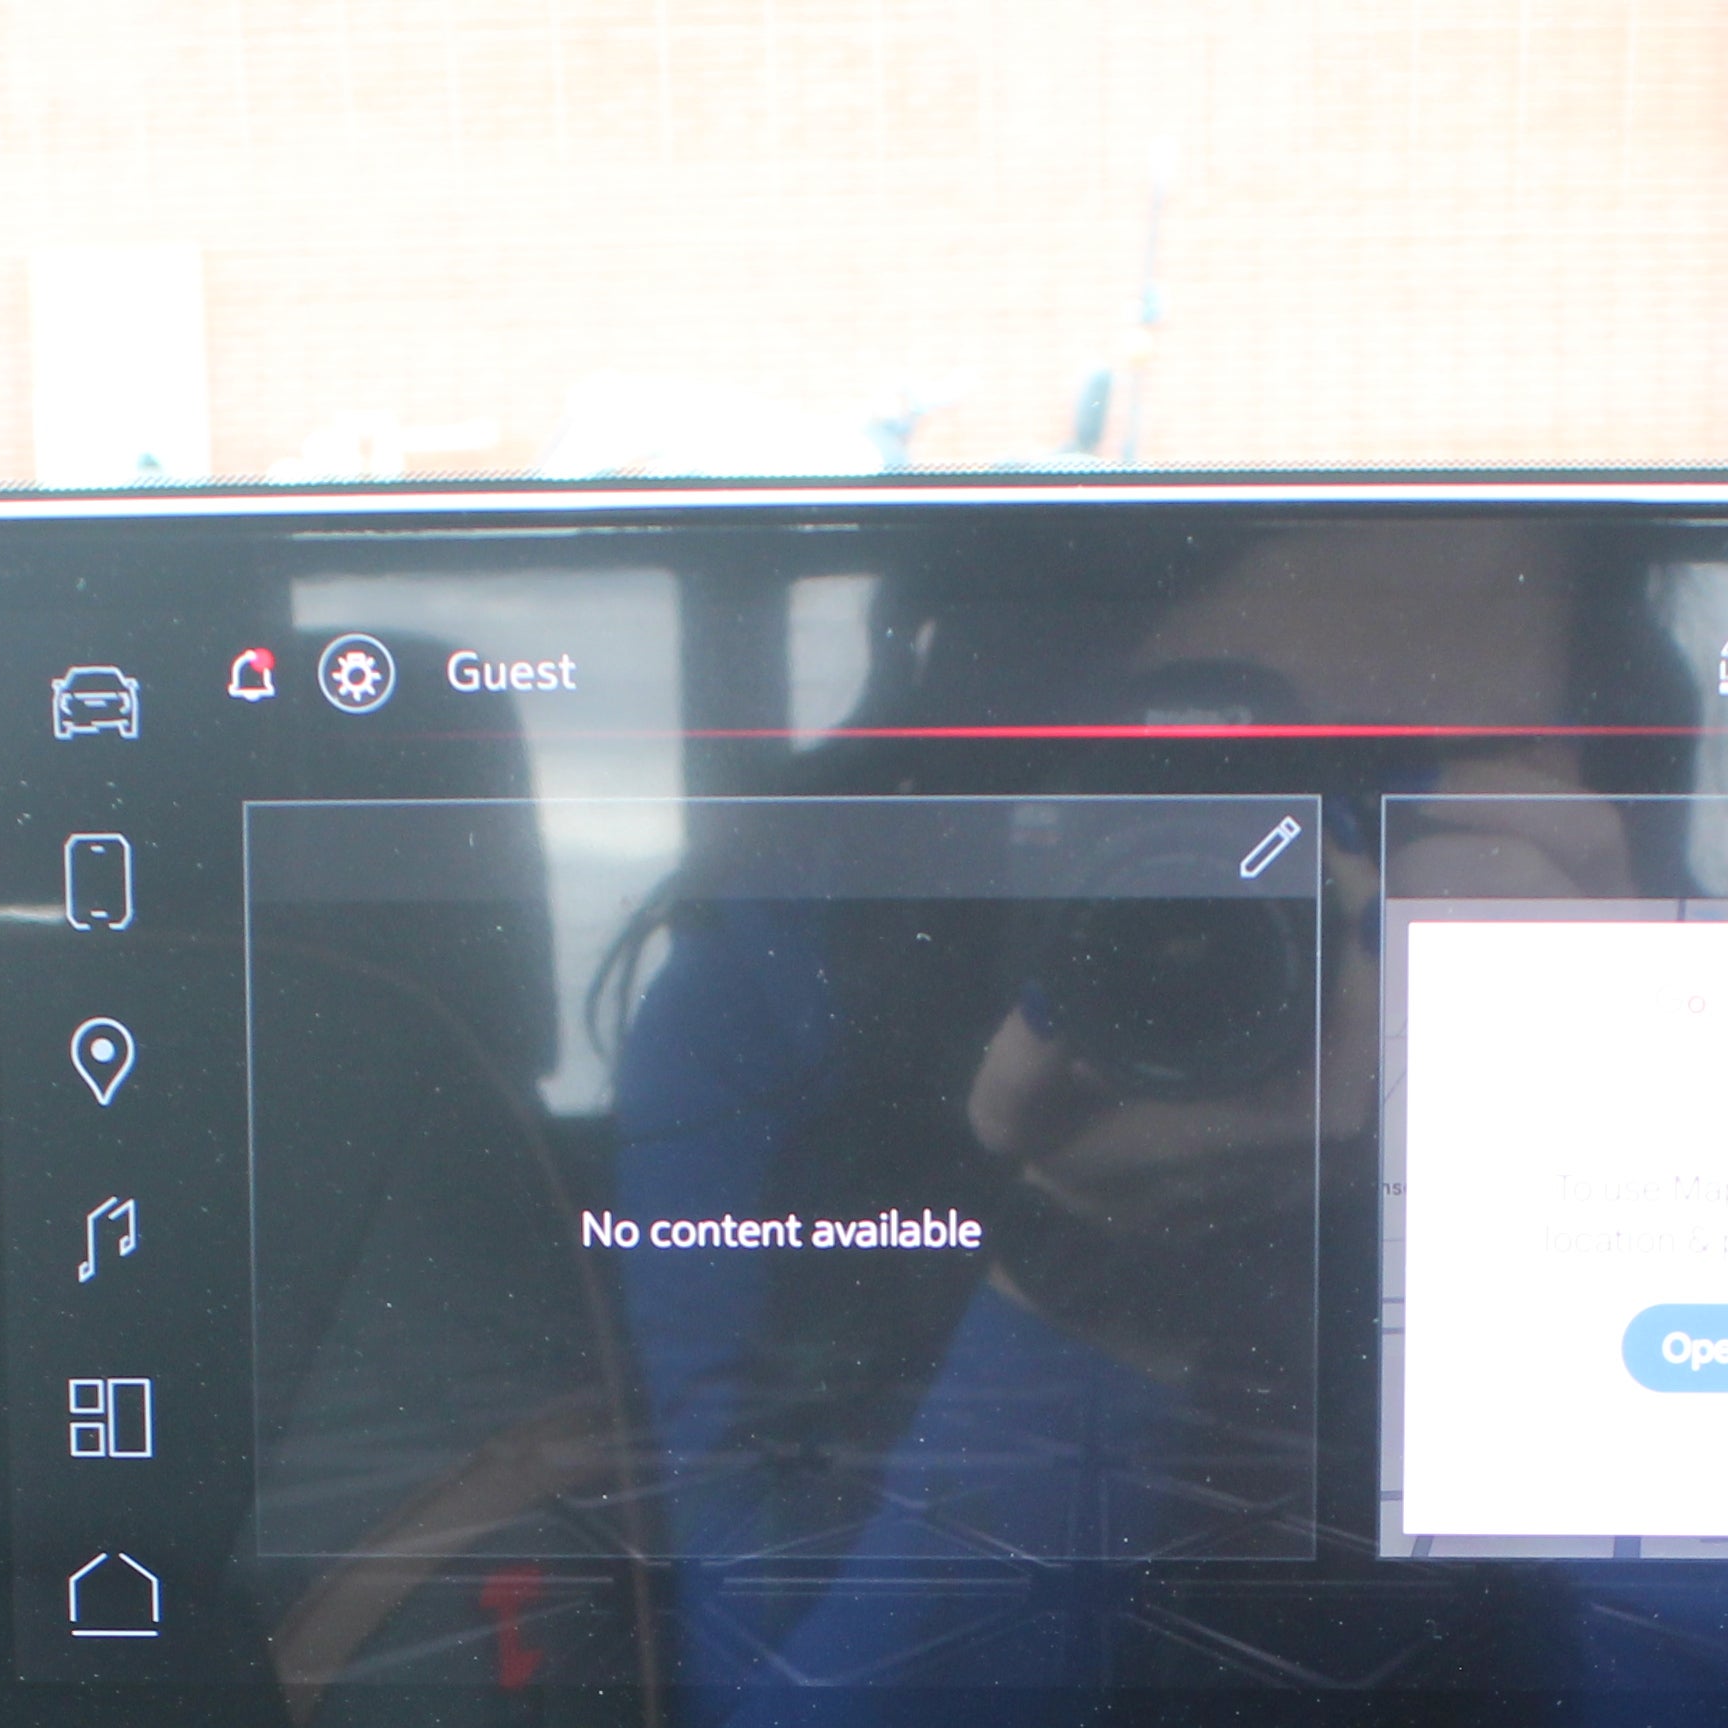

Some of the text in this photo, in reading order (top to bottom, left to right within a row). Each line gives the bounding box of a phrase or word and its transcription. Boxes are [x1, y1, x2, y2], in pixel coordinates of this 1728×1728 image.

[446, 649, 578, 692] Guest
[581, 1208, 983, 1249] No content available
